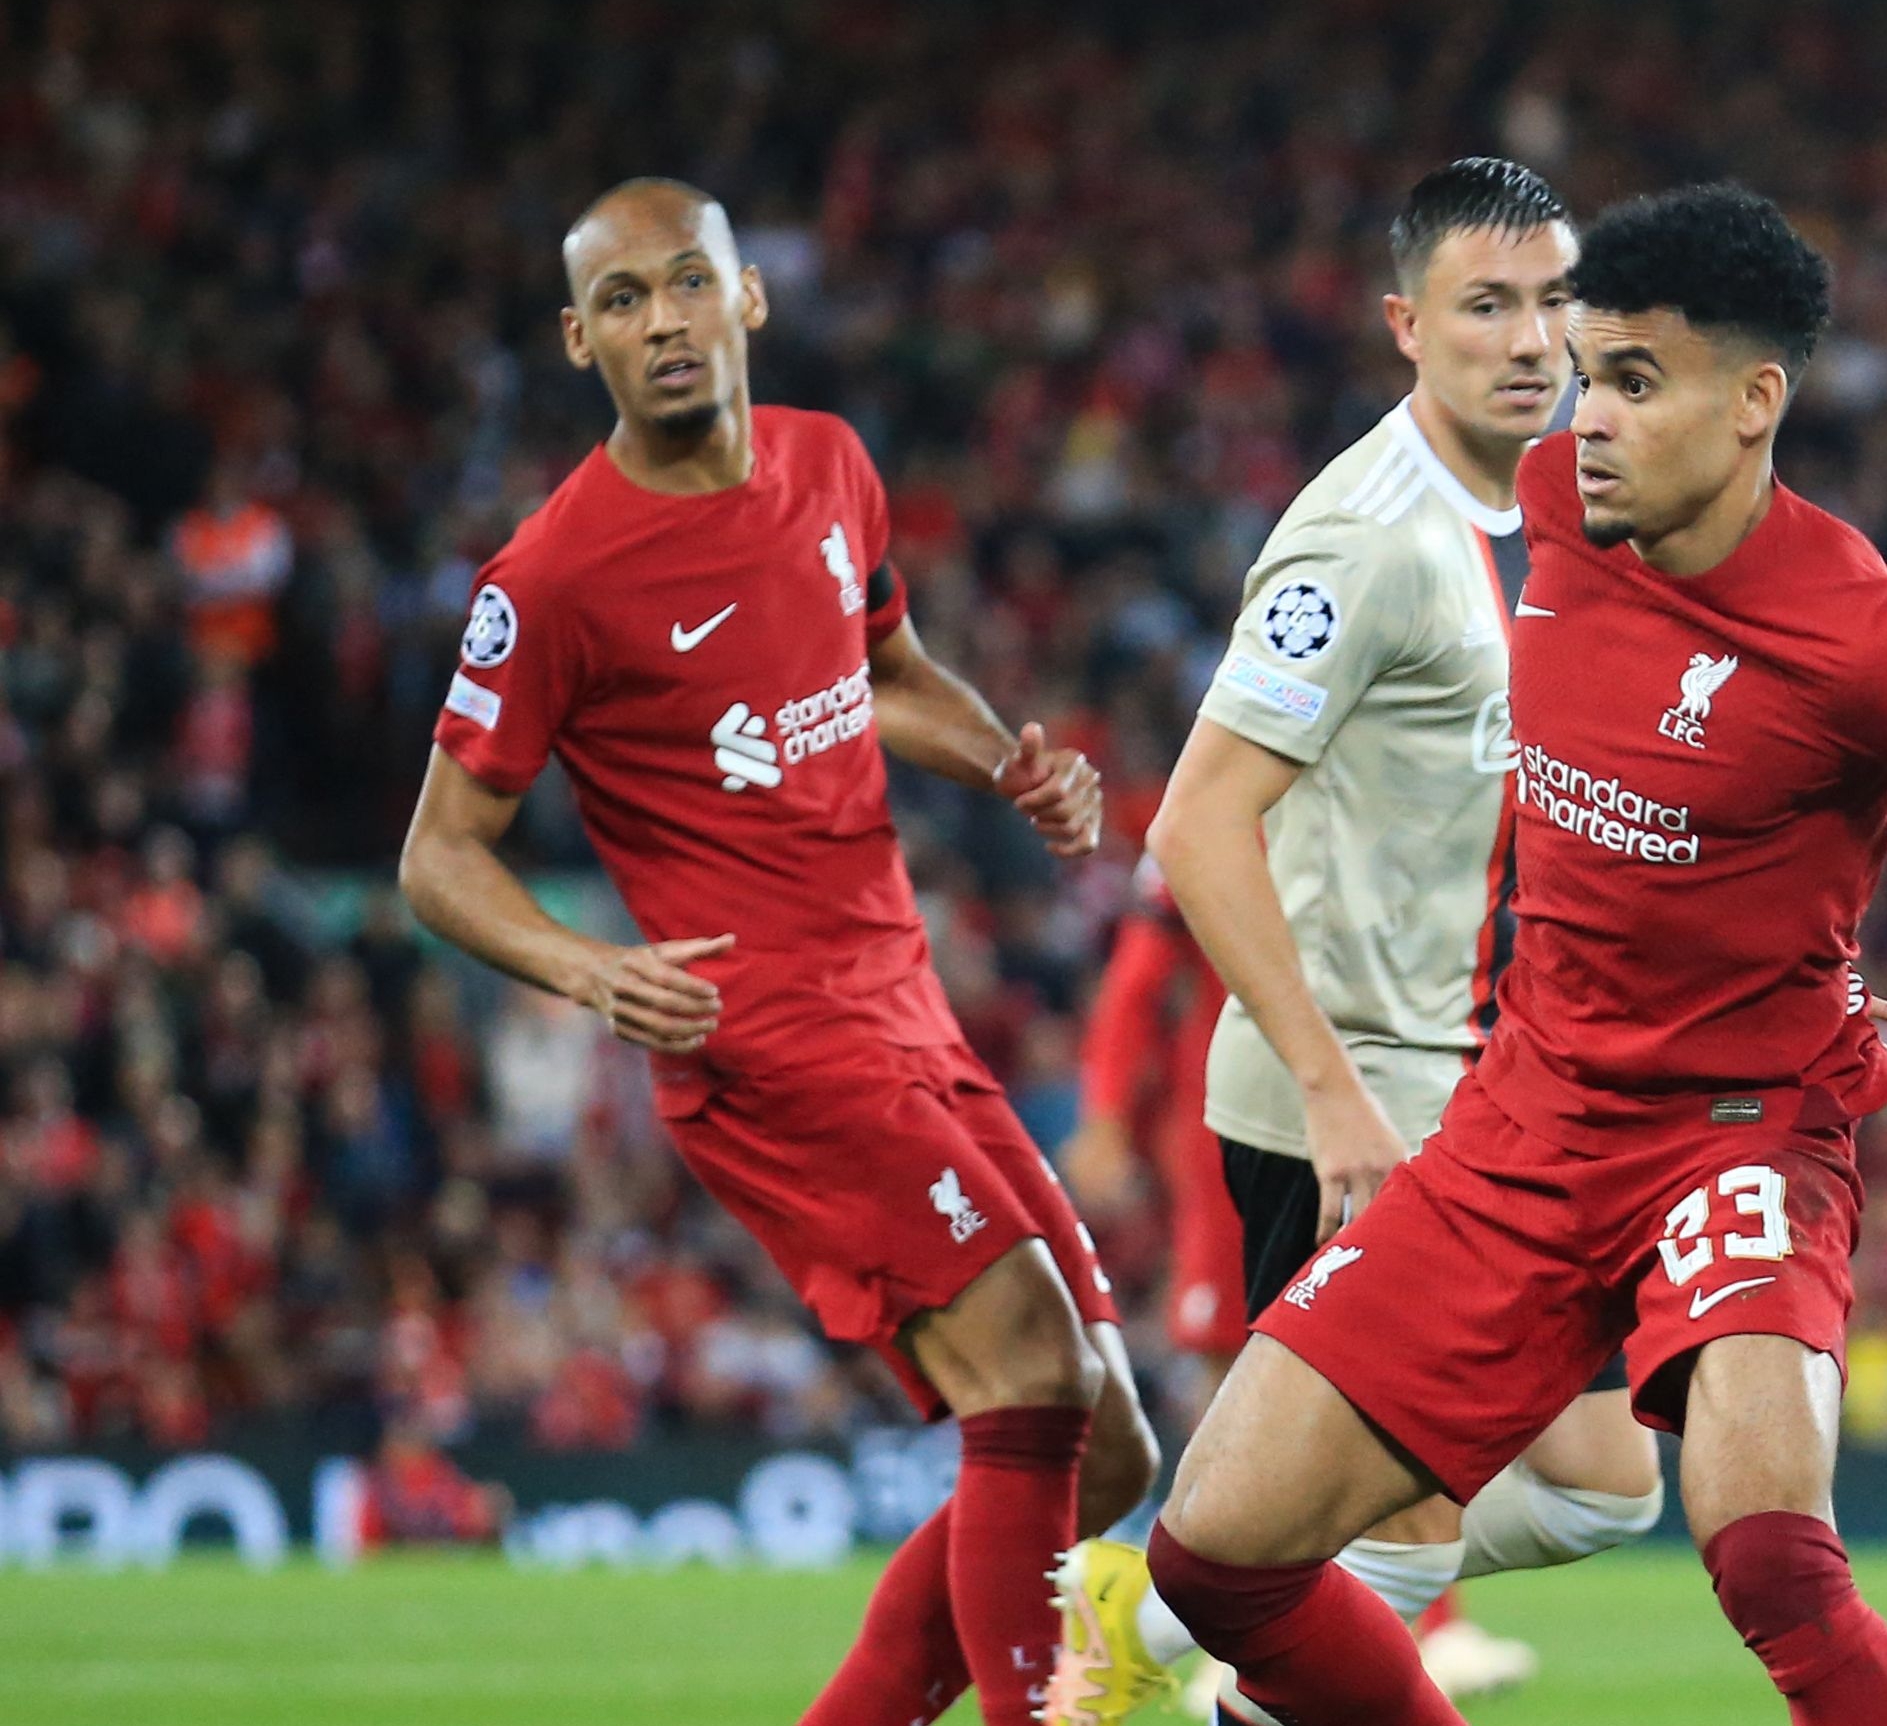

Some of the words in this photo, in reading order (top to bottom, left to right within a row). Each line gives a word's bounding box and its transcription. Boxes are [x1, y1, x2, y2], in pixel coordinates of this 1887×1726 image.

[1524, 745, 1688, 832] standard
[1529, 780, 1699, 864] chartered
[1657, 1165, 1796, 1287] 23
